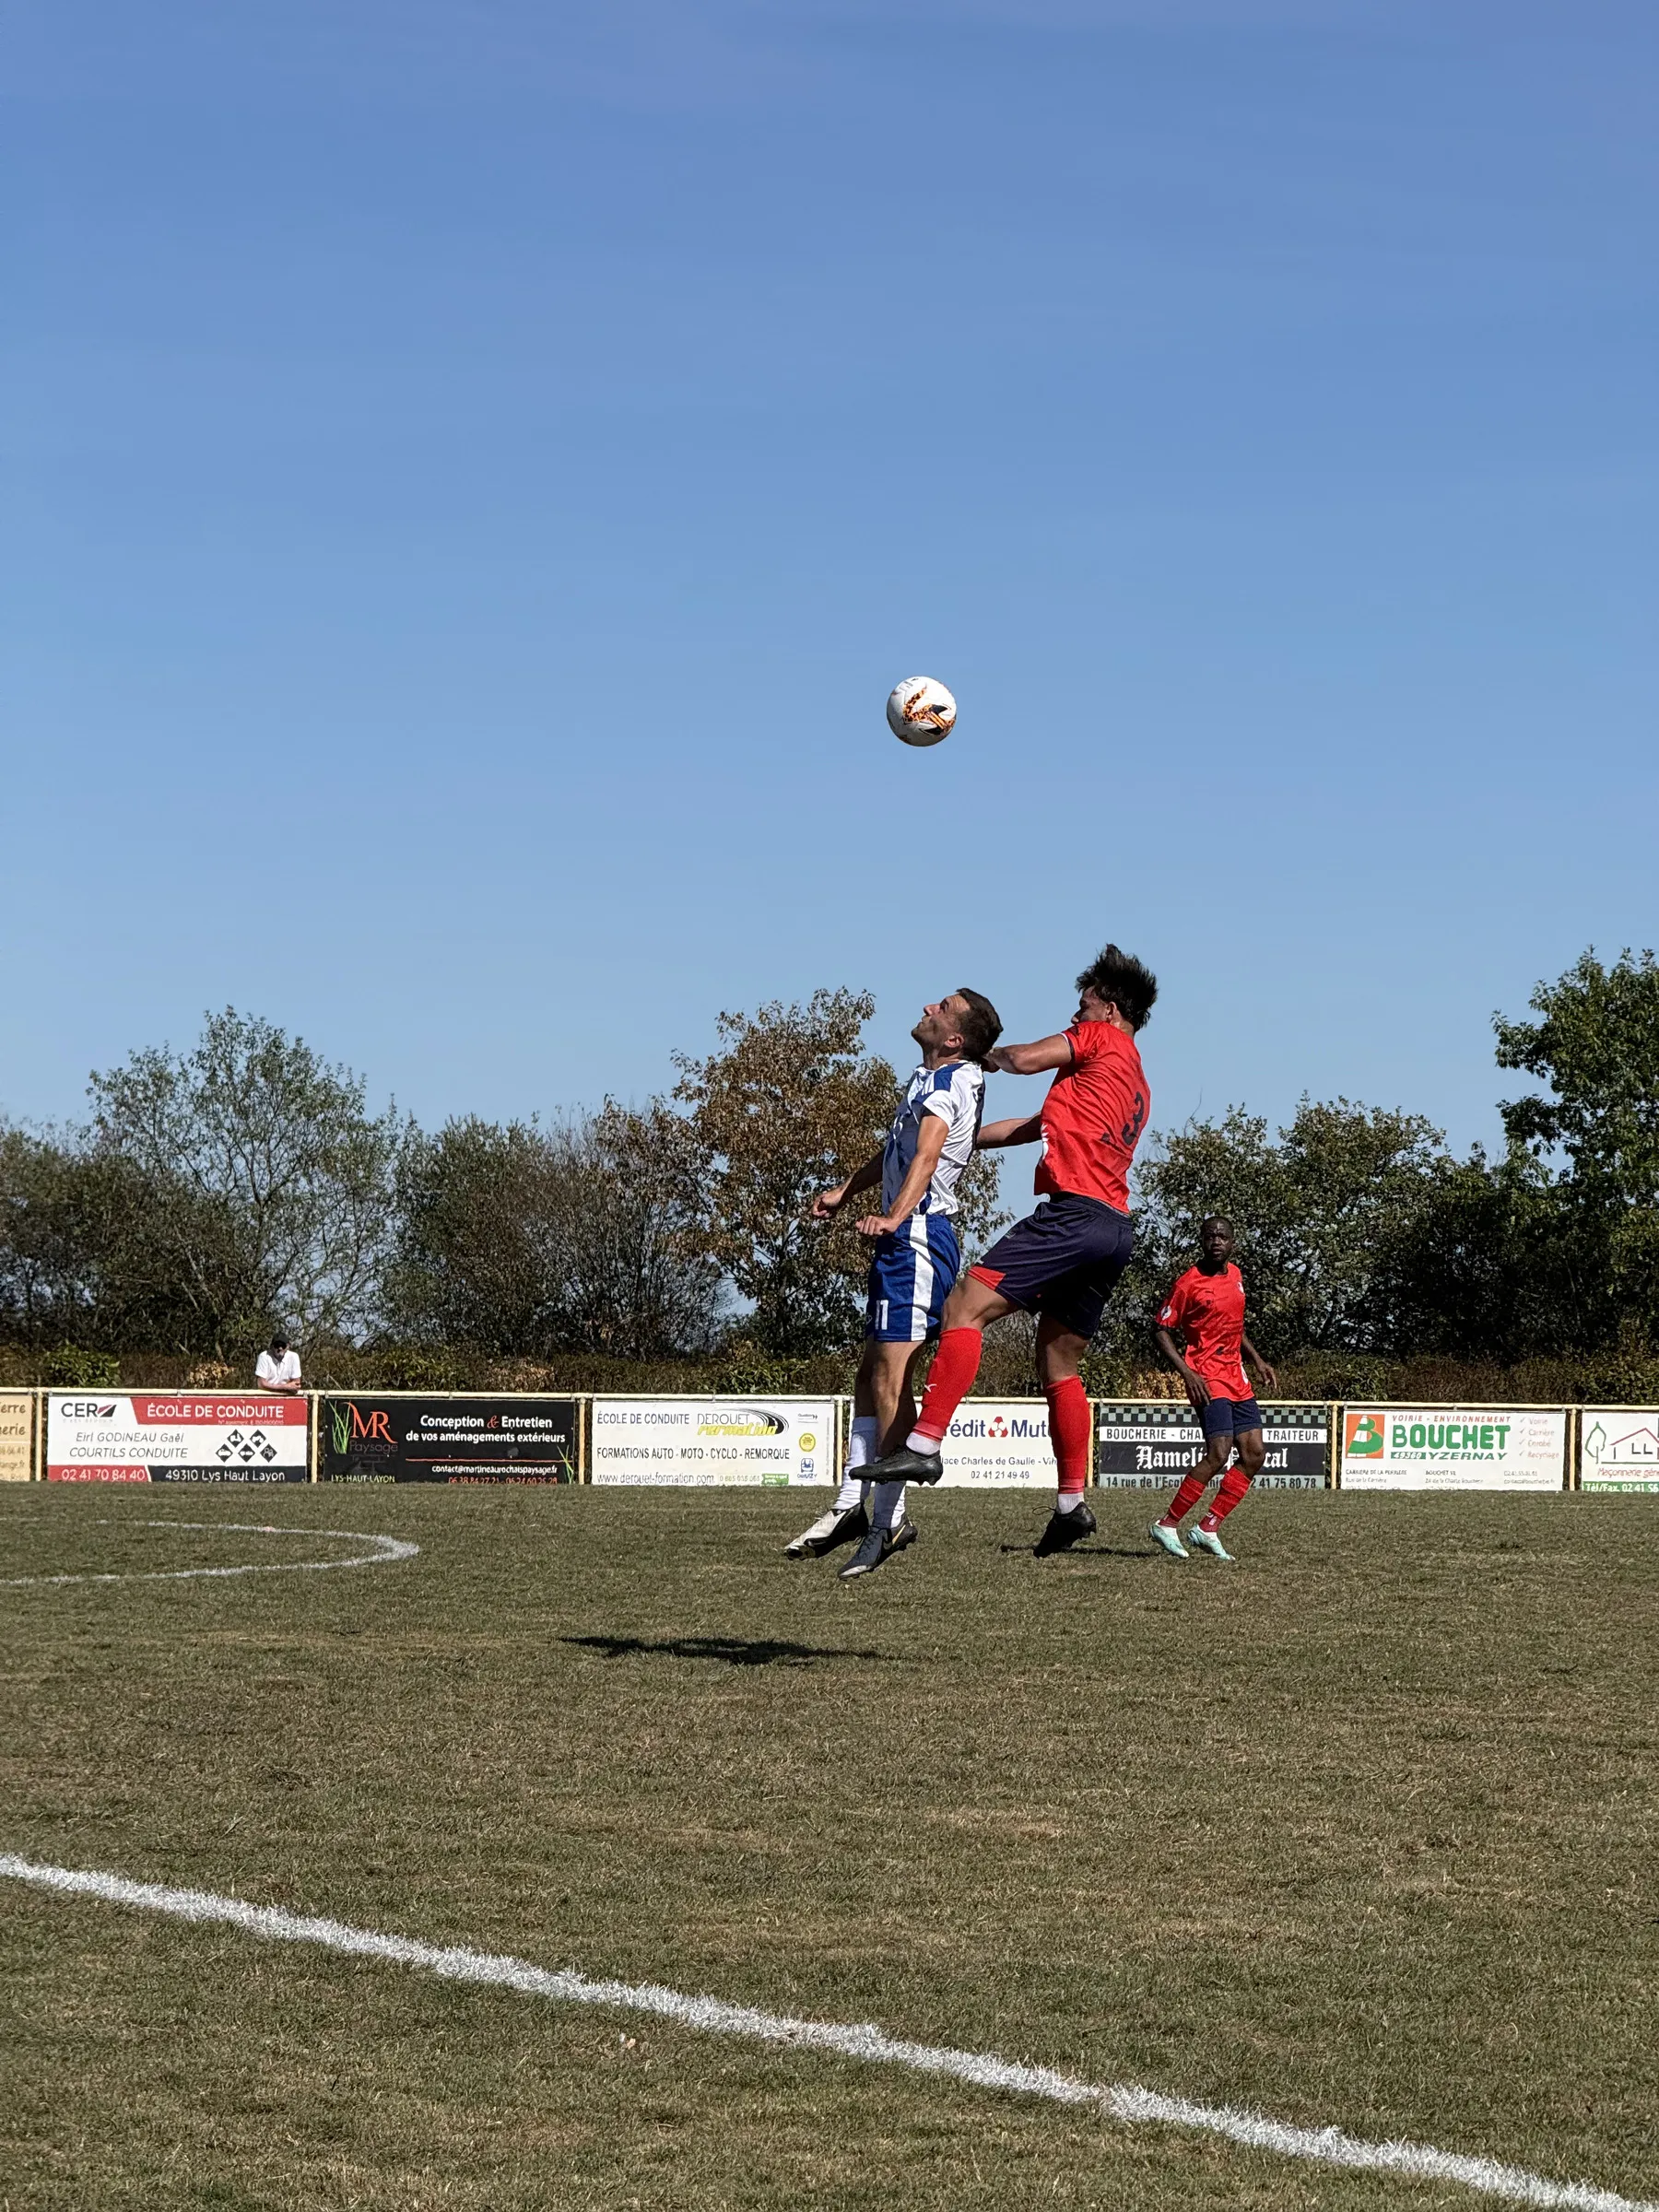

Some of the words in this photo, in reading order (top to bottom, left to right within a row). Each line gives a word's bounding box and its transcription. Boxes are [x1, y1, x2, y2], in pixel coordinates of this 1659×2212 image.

[1122, 1090, 1144, 1146] 3
[0, 1404, 26, 1414] erre
[61, 1402, 98, 1418] CER
[147, 1402, 192, 1418] ÉCOLE
[194, 1406, 213, 1418] DE
[217, 1406, 284, 1418] CONDUITE
[342, 1402, 398, 1444] MR
[420, 1415, 485, 1430] Conception
[487, 1416, 500, 1429] &
[501, 1416, 553, 1429] Entretien
[597, 1411, 627, 1425] ÉCOLE
[630, 1414, 641, 1425] DE
[645, 1414, 689, 1425] CONDUITE
[697, 1414, 750, 1425] DEROUET
[943, 1419, 986, 1438] édit
[1011, 1419, 1050, 1438] Mut
[1106, 1429, 1167, 1440] BOUCHERIE
[1267, 1430, 1319, 1441] TRAITEUR
[97, 1432, 157, 1442] GODINEAU
[406, 1430, 418, 1441] de
[421, 1432, 438, 1441] vos
[440, 1431, 515, 1444] aménagements
[517, 1431, 566, 1443] extérieurs
[1392, 1424, 1512, 1450] BOUCHET
[69, 1447, 125, 1458] COURTILS
[129, 1447, 189, 1458] CONDUITE
[349, 1441, 398, 1454] Paysage
[597, 1447, 649, 1459] FORMATIONS
[652, 1447, 675, 1460] AUTO
[680, 1448, 704, 1460] MOTO
[710, 1448, 737, 1460] CYCLO
[745, 1449, 790, 1460] REMORQUE
[1631, 1442, 1653, 1454] LL
[941, 1457, 959, 1465] lace
[960, 1456, 994, 1465] Charles
[995, 1456, 1006, 1465] de
[1008, 1456, 1036, 1465] Gaulle
[1042, 1457, 1057, 1465] Vih
[1135, 1445, 1207, 1470] Hameli
[1429, 1452, 1508, 1460] YZERNAY
[62, 1469, 74, 1481] 02
[79, 1468, 91, 1480] 41
[96, 1468, 109, 1480] 70
[129, 1469, 146, 1480] 40
[166, 1469, 198, 1481] 49310
[202, 1469, 221, 1483] Lys
[224, 1470, 249, 1481] Haut
[253, 1470, 286, 1483] Layon
[331, 1475, 395, 1483] LYS-HAUT-LAYON
[971, 1471, 981, 1479] 02
[982, 1471, 992, 1479] 41
[995, 1471, 1005, 1479] 21
[1006, 1471, 1018, 1479] 49
[1019, 1471, 1030, 1480] 49
[1598, 1467, 1641, 1478] Maçonnerie
[1106, 1477, 1117, 1488] 14
[1121, 1479, 1136, 1488] rue
[1139, 1477, 1152, 1488] de
[1156, 1477, 1183, 1489] l'Ecol
[1259, 1478, 1270, 1488] 41
[1275, 1478, 1287, 1488] 75
[1290, 1478, 1301, 1488] 80
[1304, 1478, 1316, 1488] 78
[1622, 1483, 1633, 1492] 02
[1635, 1483, 1645, 1492] 41
[1648, 1483, 1659, 1493] 56
